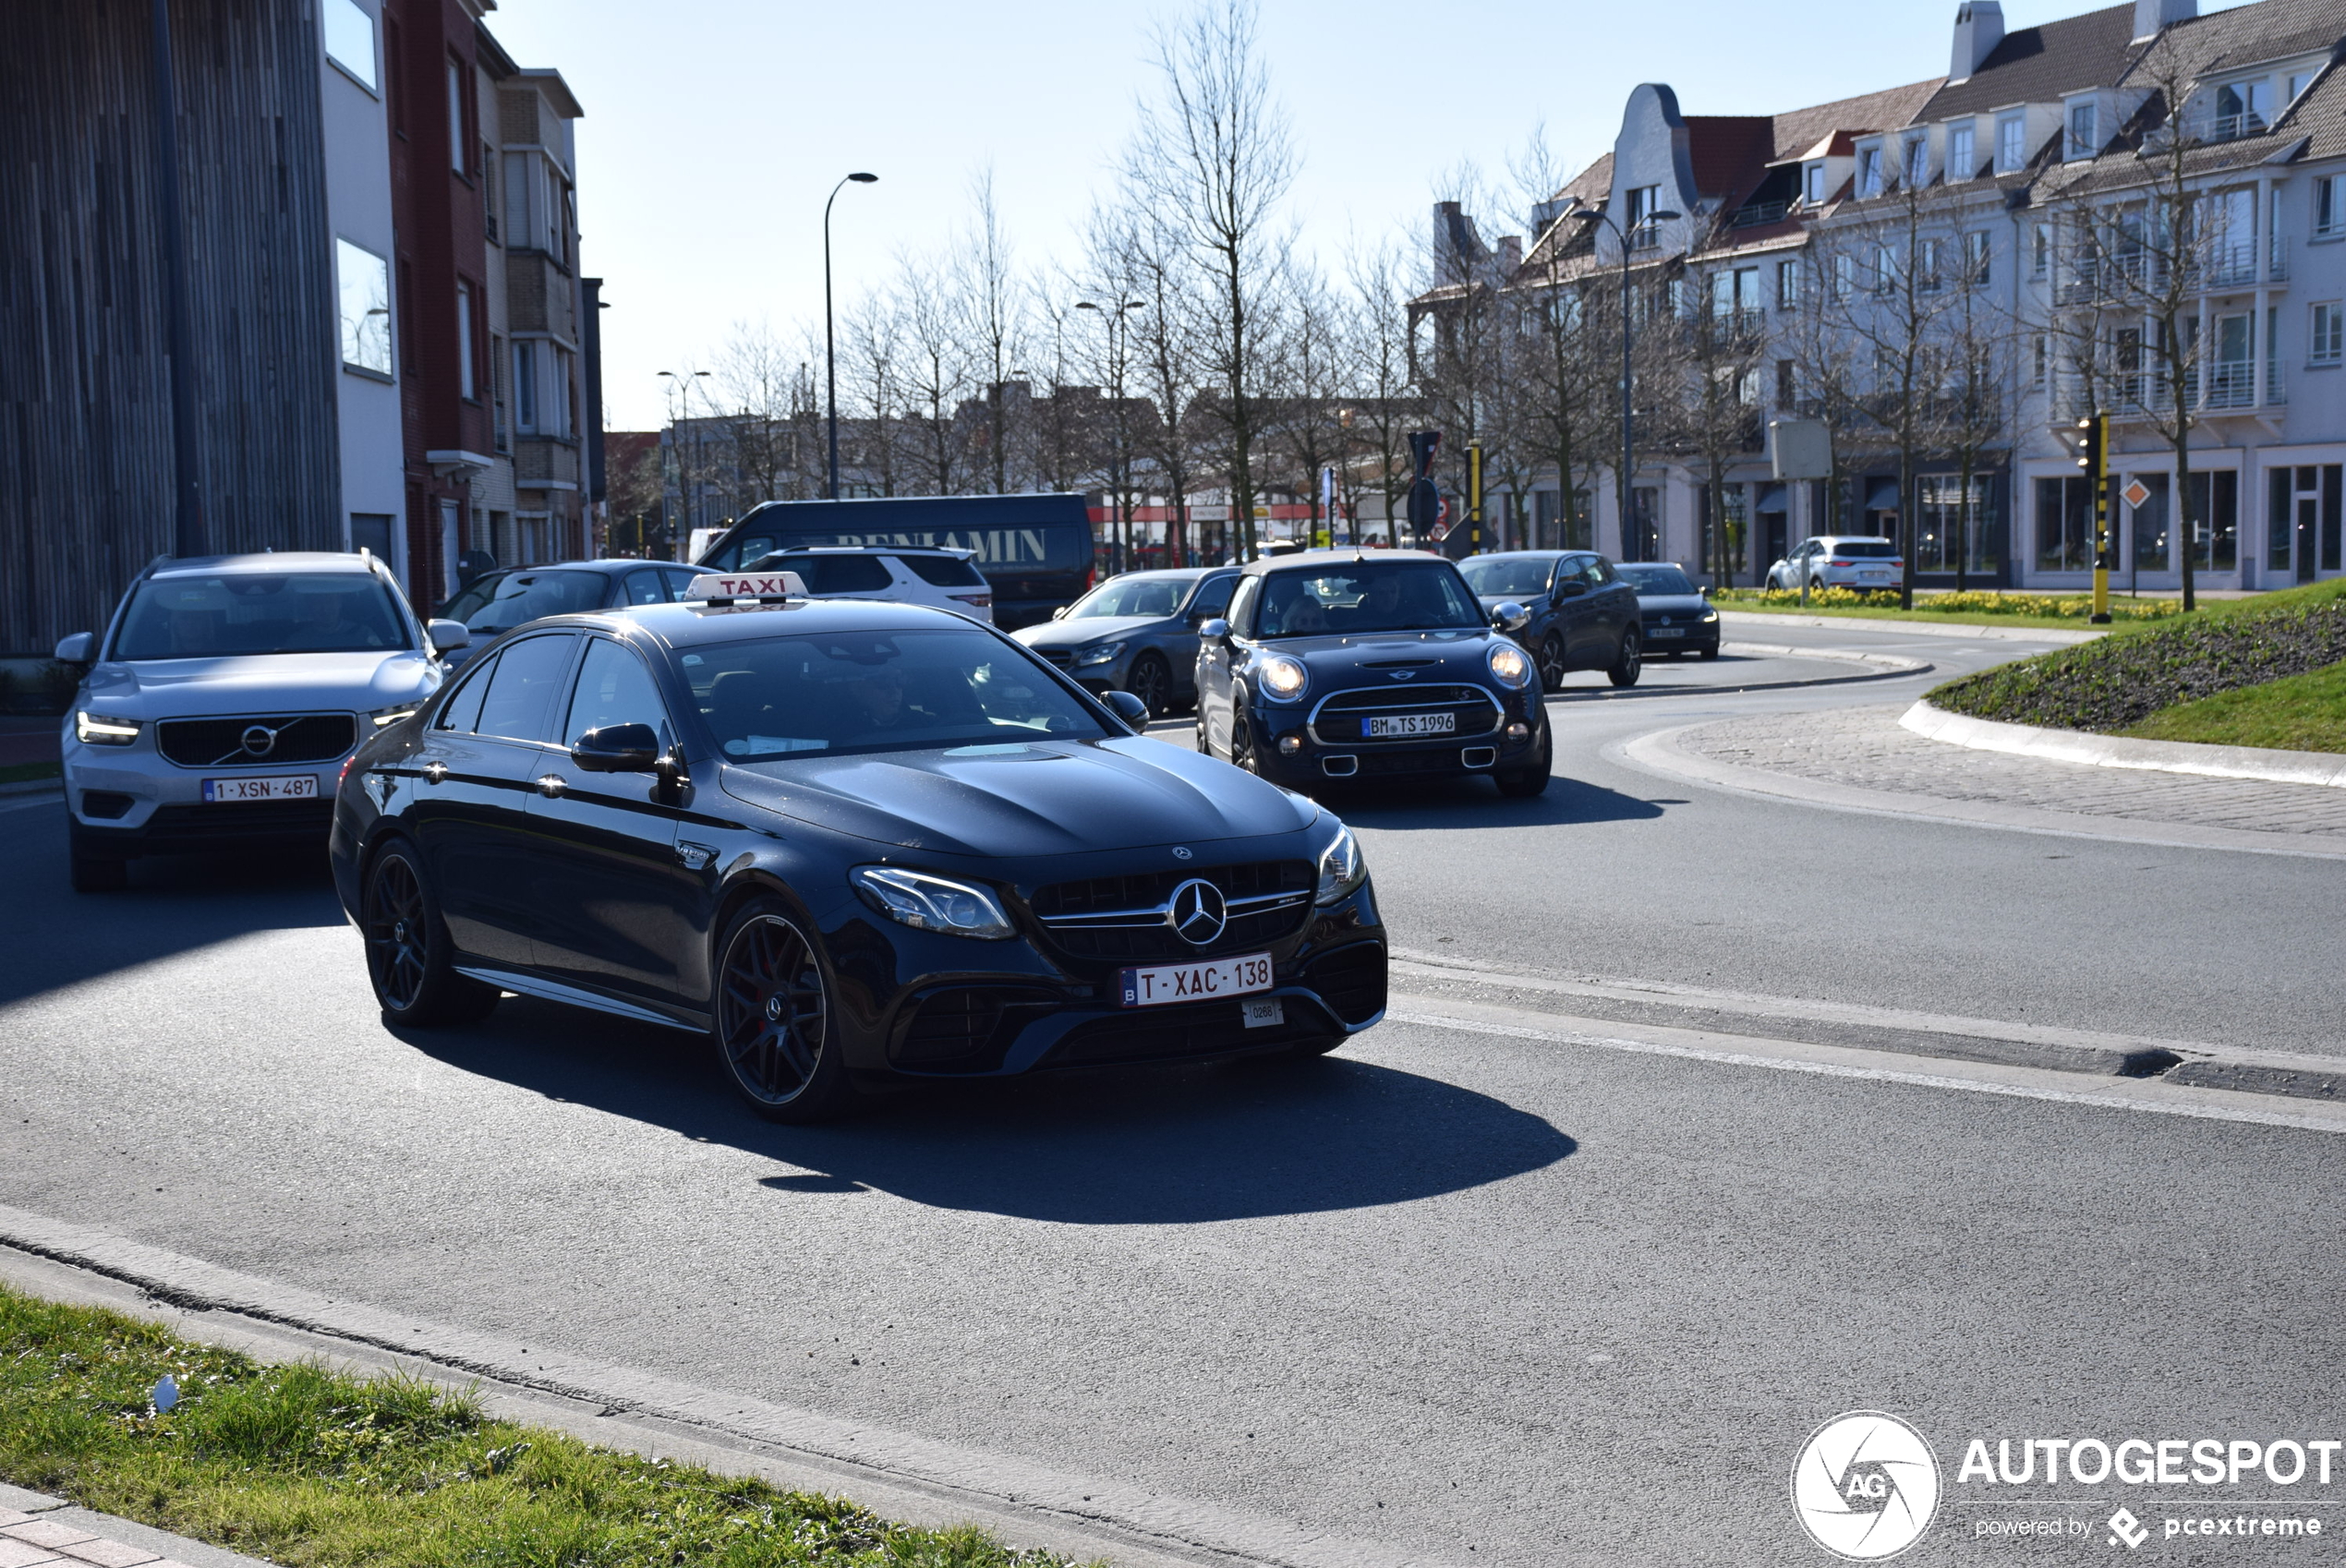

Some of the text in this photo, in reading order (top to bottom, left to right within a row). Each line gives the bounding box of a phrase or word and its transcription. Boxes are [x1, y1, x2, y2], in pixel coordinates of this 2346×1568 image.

[720, 578, 786, 595] TAXI
[1371, 718, 1388, 734] BM
[1421, 715, 1454, 730] 1996
[1125, 990, 1135, 1001] B
[1252, 1006, 1273, 1019] 0268
